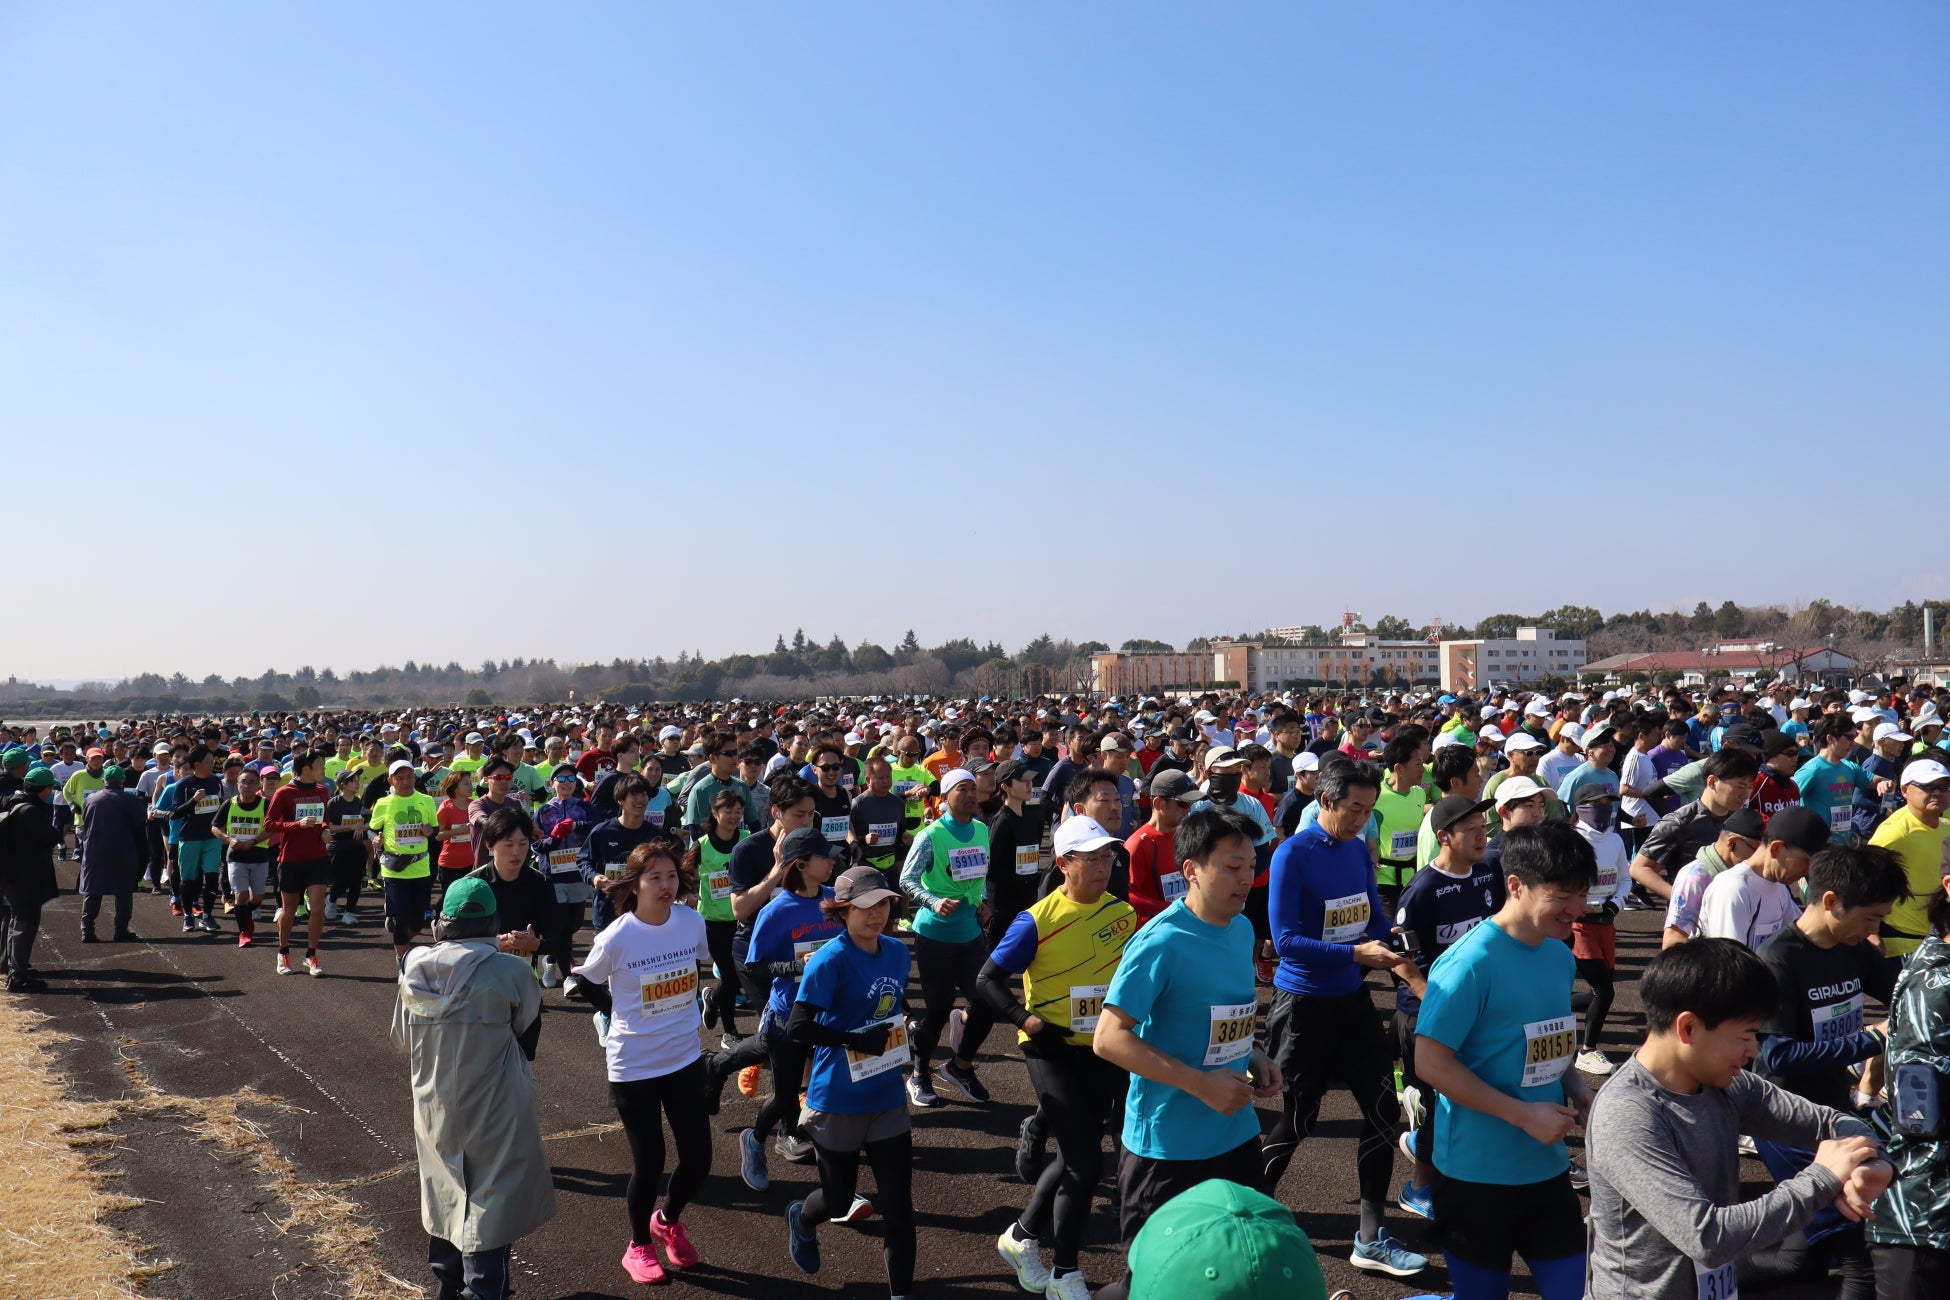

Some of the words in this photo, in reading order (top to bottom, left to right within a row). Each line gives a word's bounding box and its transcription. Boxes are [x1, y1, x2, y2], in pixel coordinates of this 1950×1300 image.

[1765, 798, 1799, 812] Rakute
[825, 822, 843, 832] 2609
[955, 855, 979, 868] 5911
[980, 853, 986, 865] E
[1331, 907, 1359, 926] 8028
[1362, 904, 1367, 920] F
[1098, 919, 1129, 943] S&D
[627, 955, 661, 969] SHINSHU
[645, 973, 695, 1001] 10405F
[1218, 1017, 1252, 1043] 3816
[1821, 1013, 1852, 1041] 5980
[1533, 1034, 1562, 1062] 3815
[1566, 1032, 1572, 1054] F
